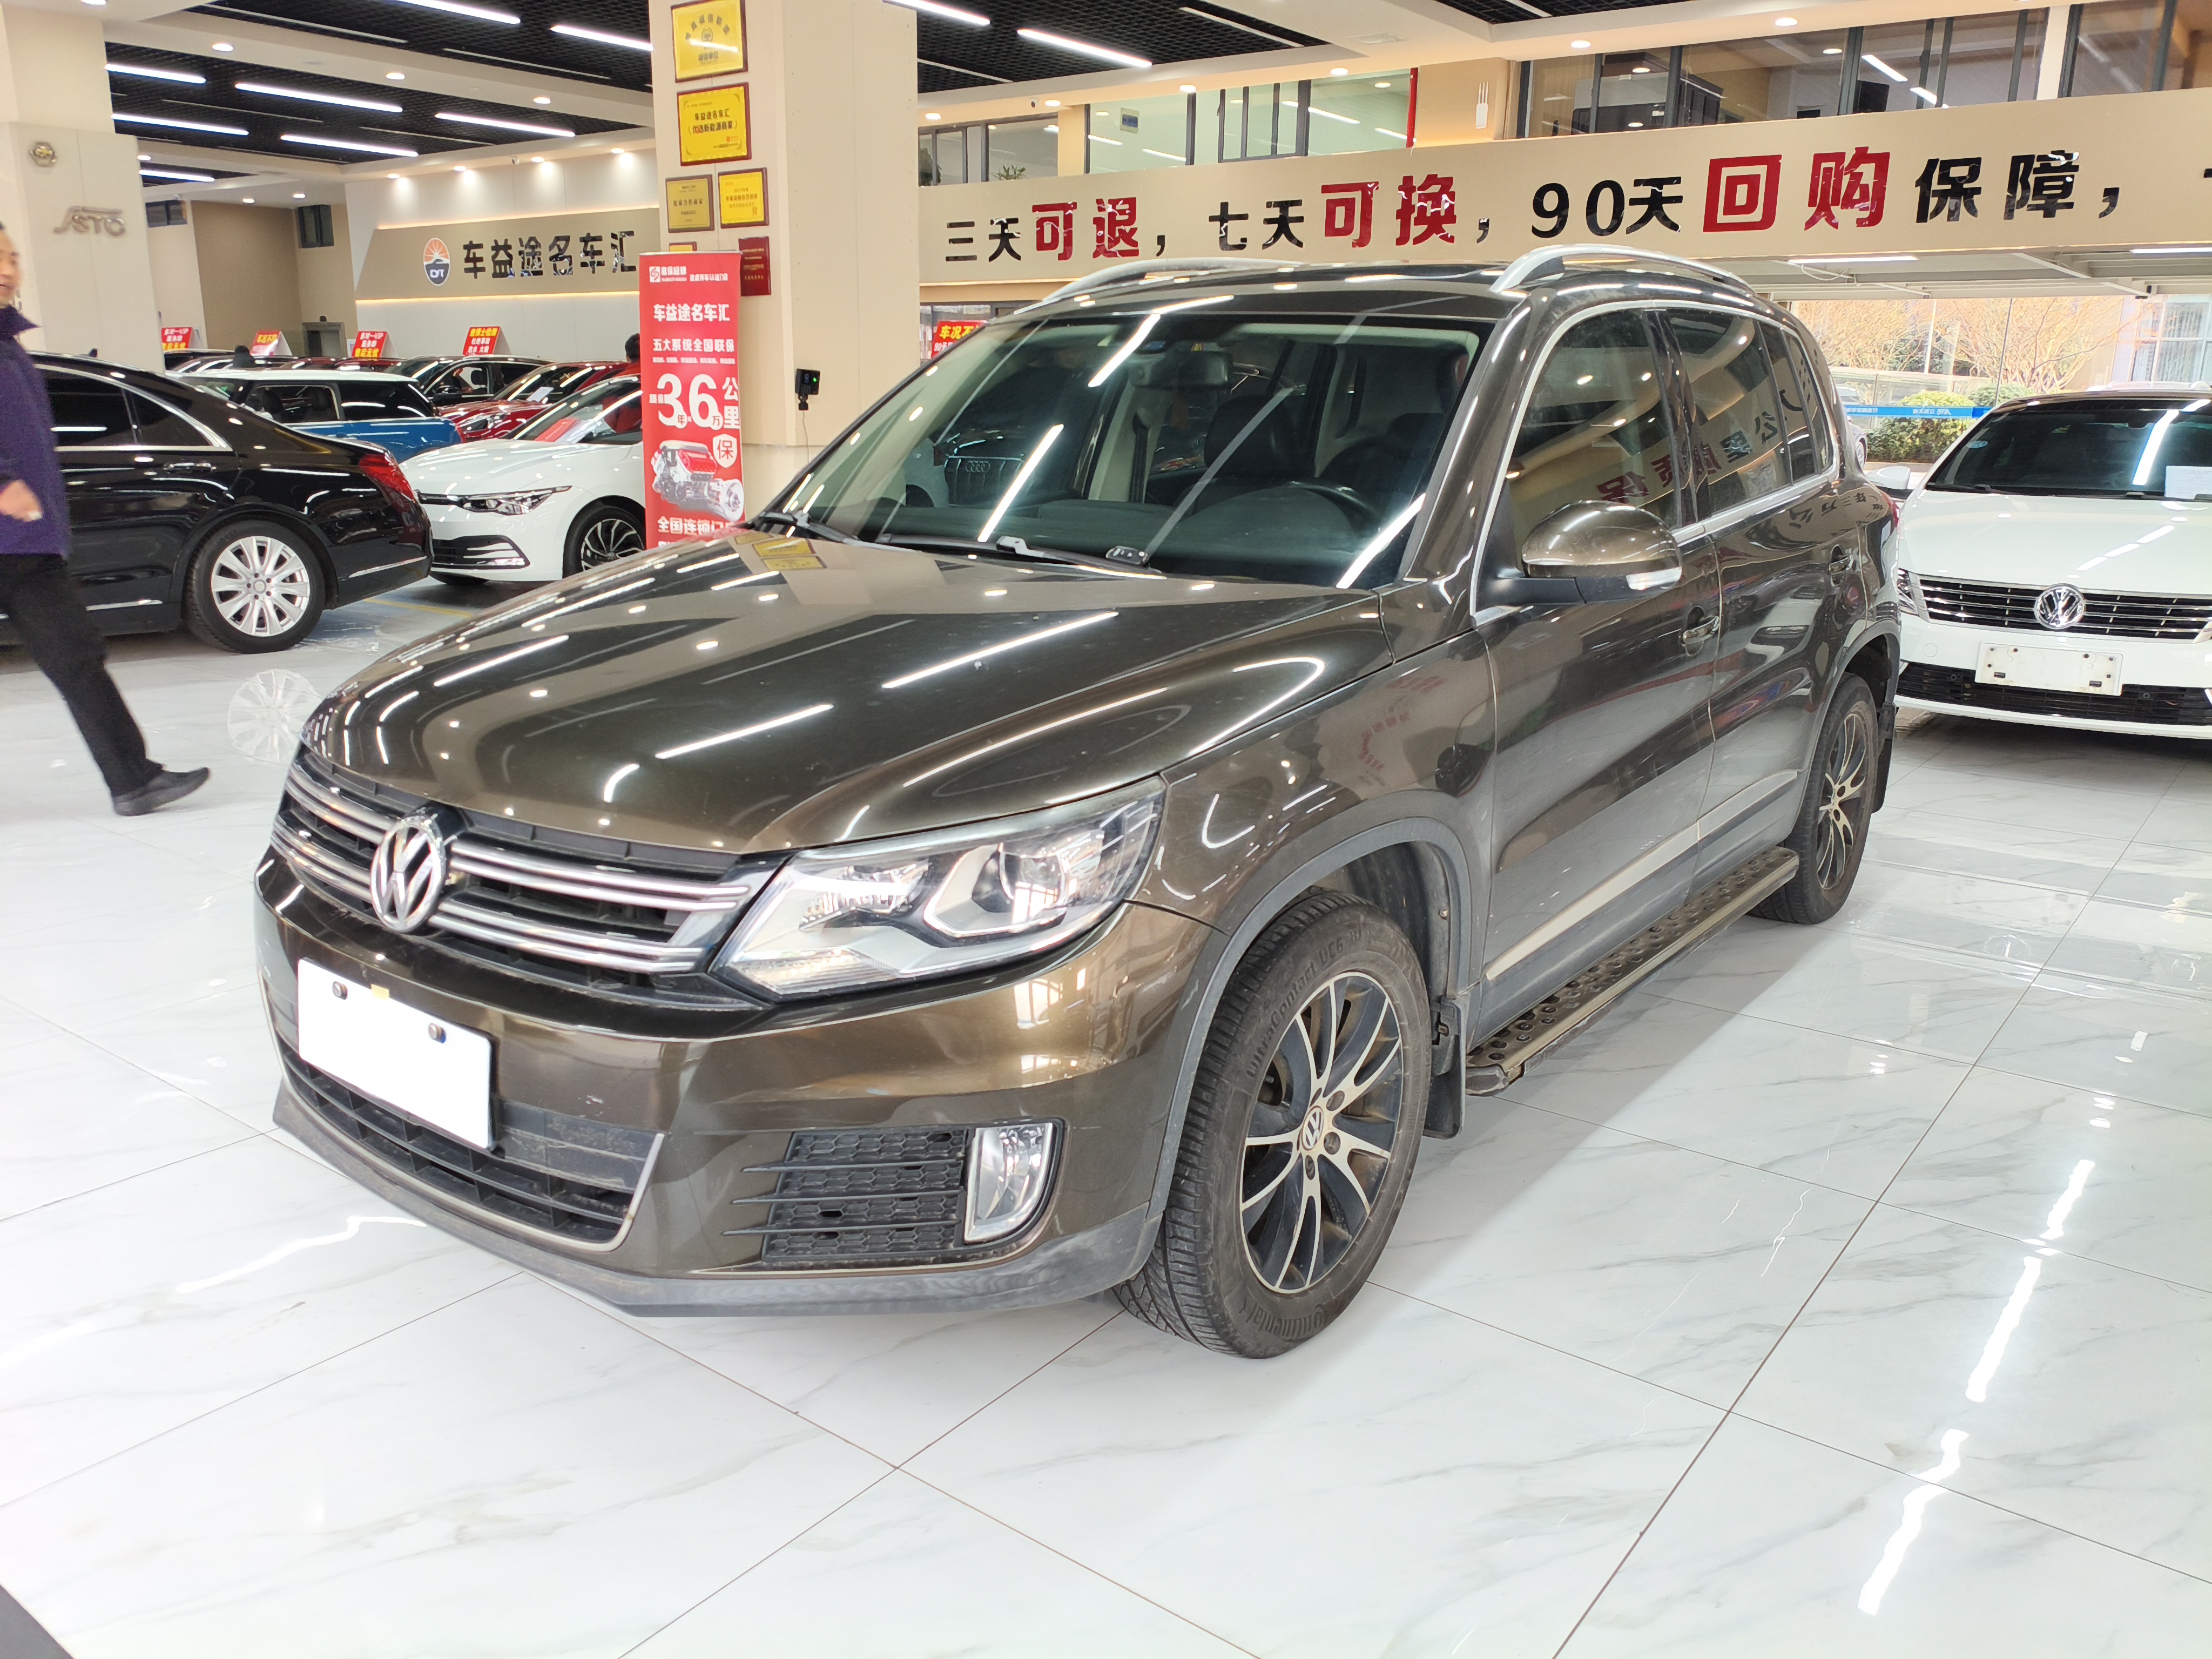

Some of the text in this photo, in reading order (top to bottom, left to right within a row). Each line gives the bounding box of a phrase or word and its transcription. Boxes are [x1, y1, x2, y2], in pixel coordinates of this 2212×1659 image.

[463, 231, 637, 279] 车益途名车汇
[653, 304, 731, 322] 车益途名车汇
[939, 325, 980, 340] 车况不
[653, 338, 735, 353] 五大系统全国联保
[717, 439, 734, 460] 保
